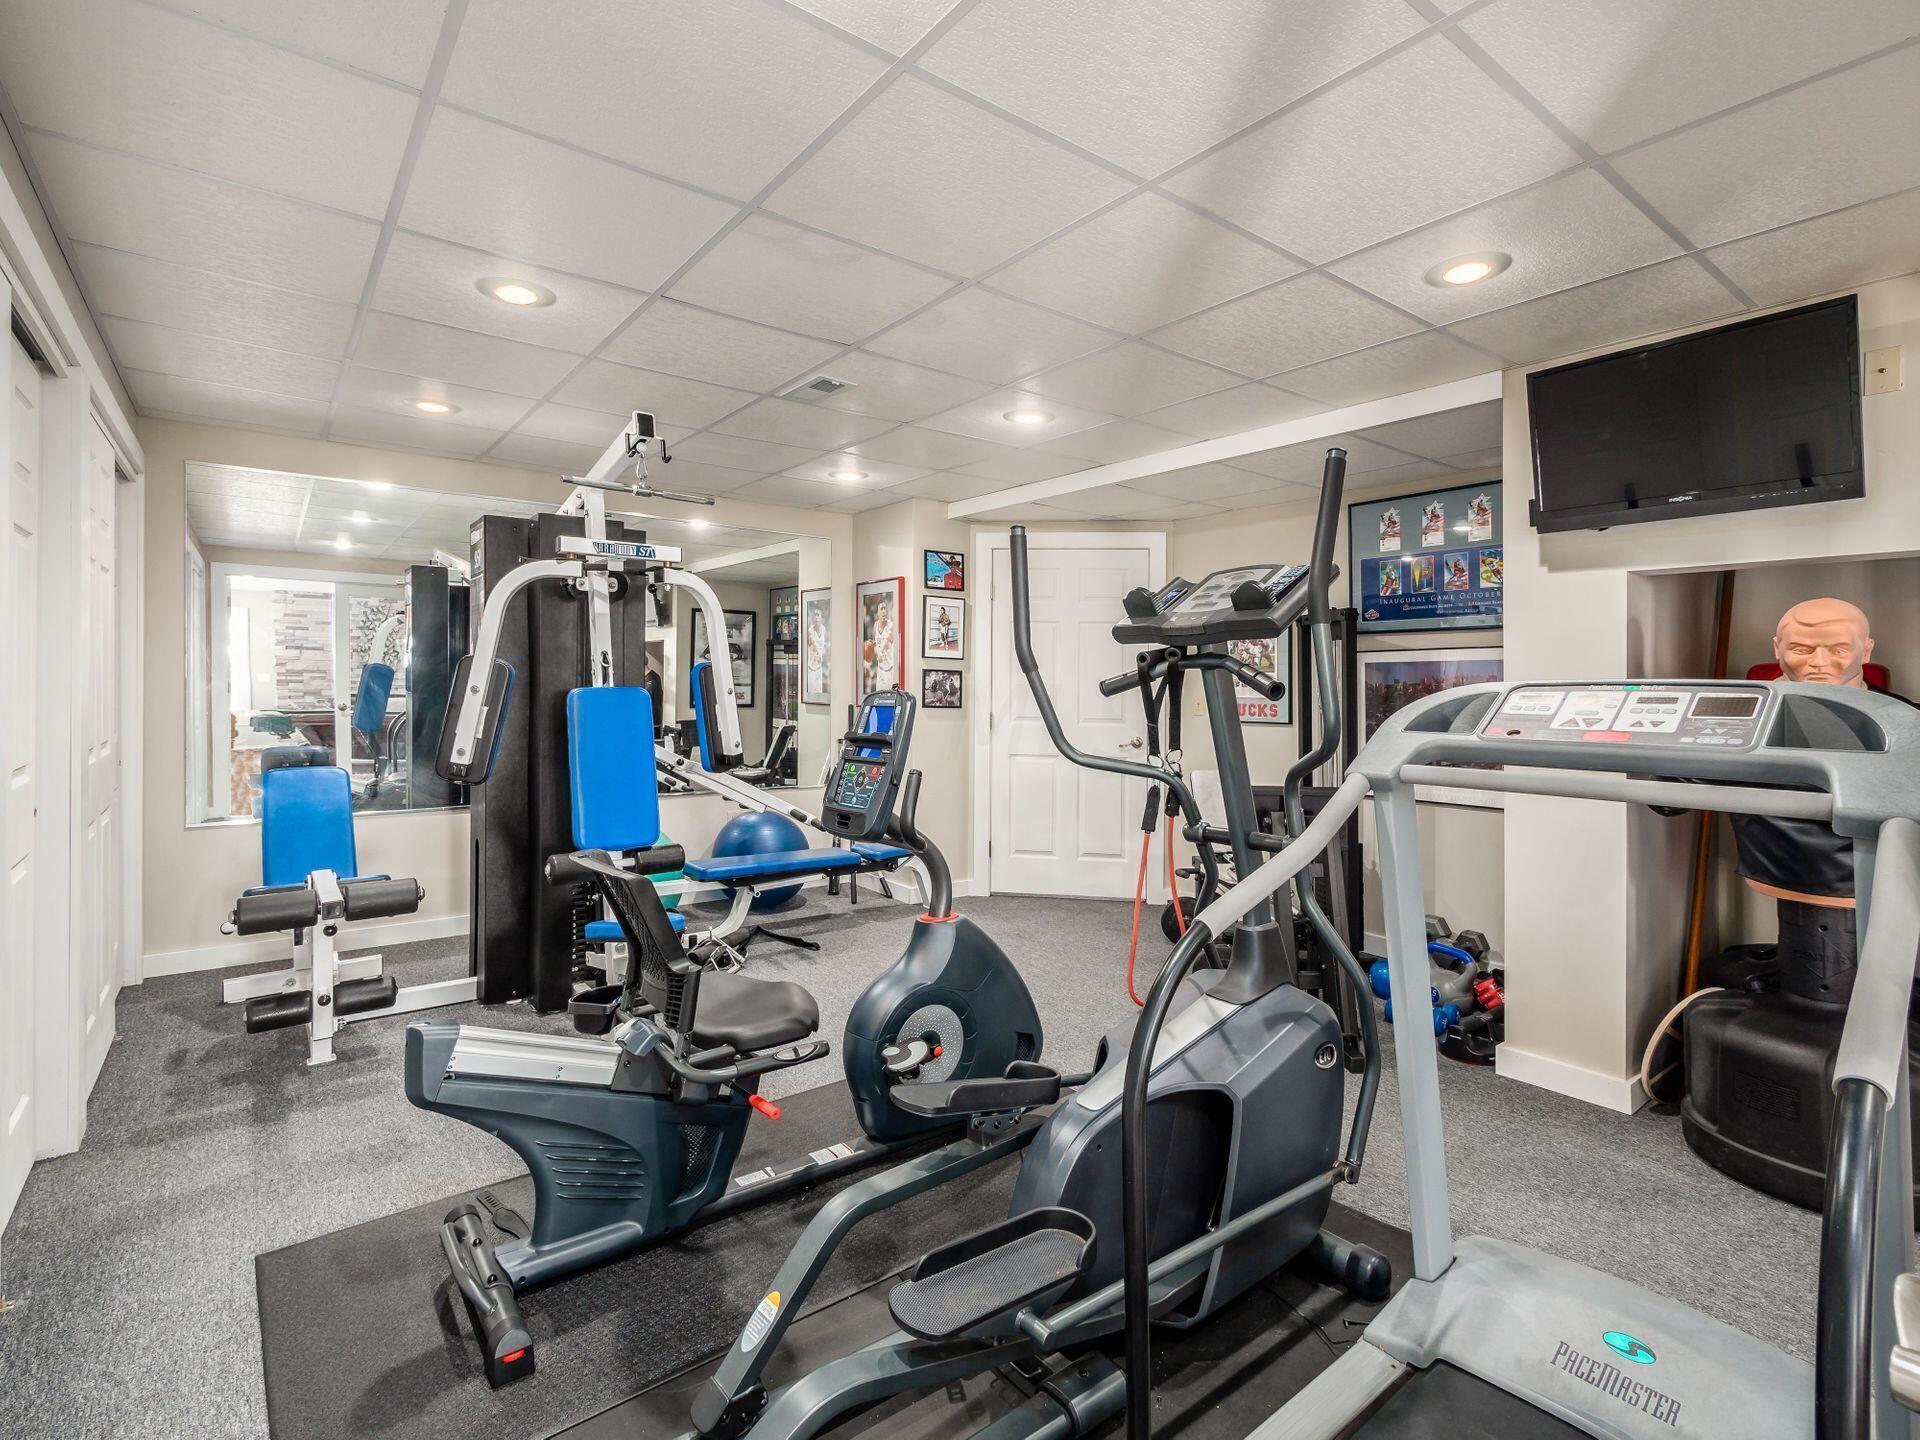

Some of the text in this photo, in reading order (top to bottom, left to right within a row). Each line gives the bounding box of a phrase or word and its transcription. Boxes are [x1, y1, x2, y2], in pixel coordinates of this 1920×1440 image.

[1379, 591, 1502, 606] INAUGURAL GAME OCTOBER
[1237, 703, 1278, 718] UCKS
